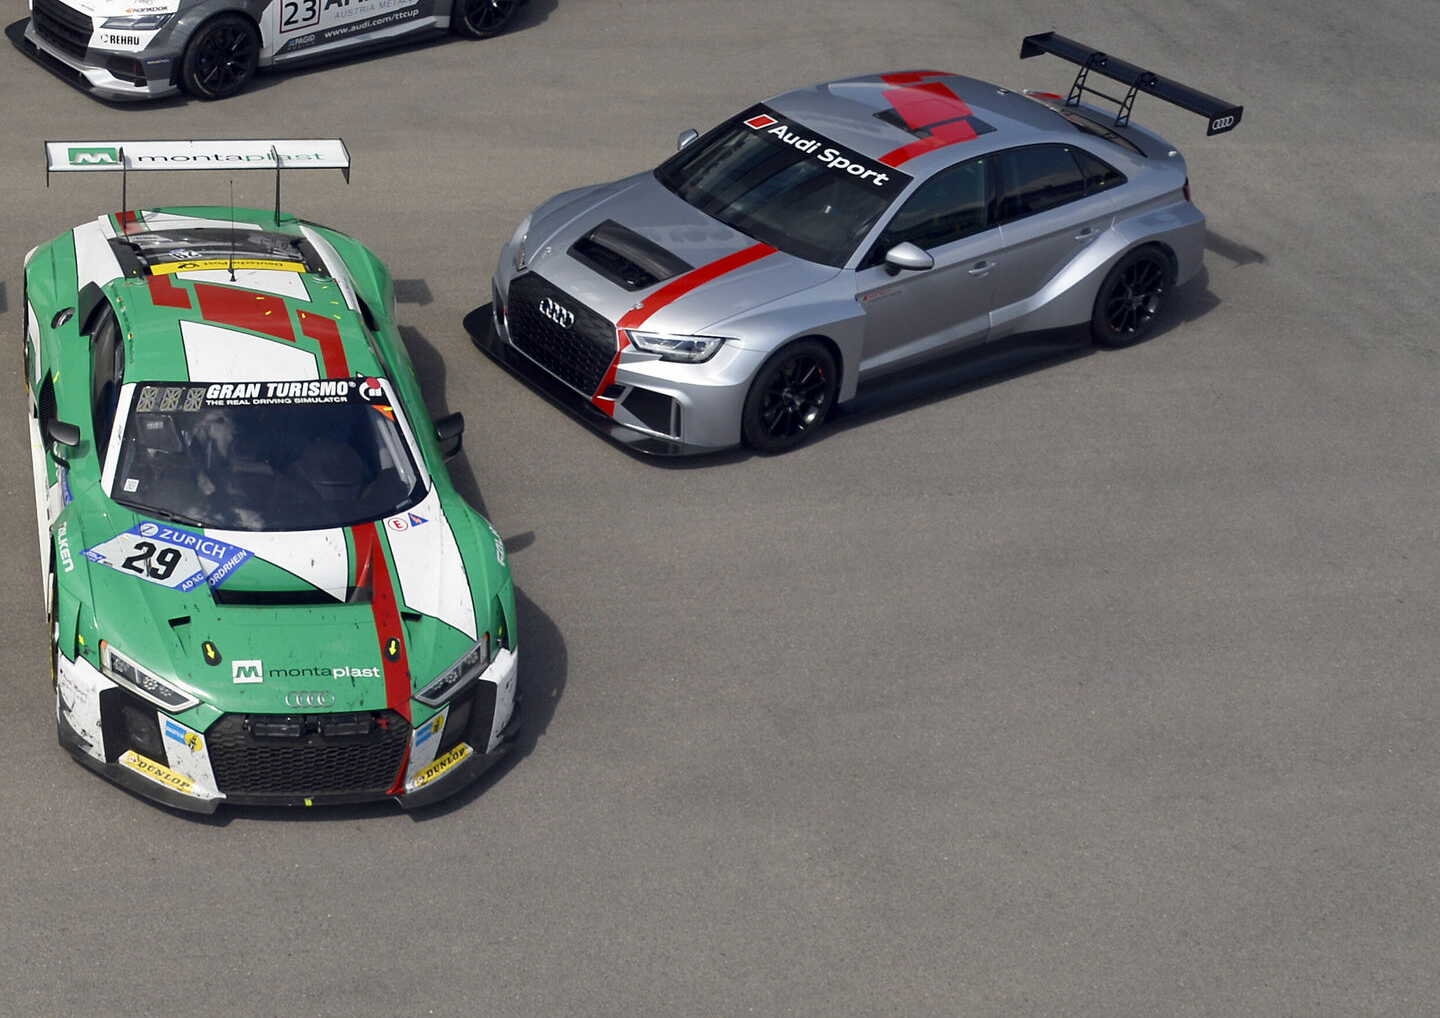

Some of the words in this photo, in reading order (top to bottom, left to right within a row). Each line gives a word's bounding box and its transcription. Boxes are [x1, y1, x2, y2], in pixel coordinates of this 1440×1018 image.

[324, 8, 420, 39] www.audi.com/ttcup
[335, 3, 376, 20] AUSTRIA
[110, 34, 140, 46] REHAU
[768, 125, 822, 154] Audi
[817, 148, 890, 186] Sport
[205, 384, 259, 399] GRAN
[265, 381, 348, 398] TURISMO
[159, 529, 227, 559] ZURICH
[121, 540, 182, 581] 29
[208, 549, 247, 587] ORDRHEIN
[269, 666, 381, 679] montaplast
[137, 761, 191, 788] DUNLOP
[426, 748, 466, 778] DUNLOP
